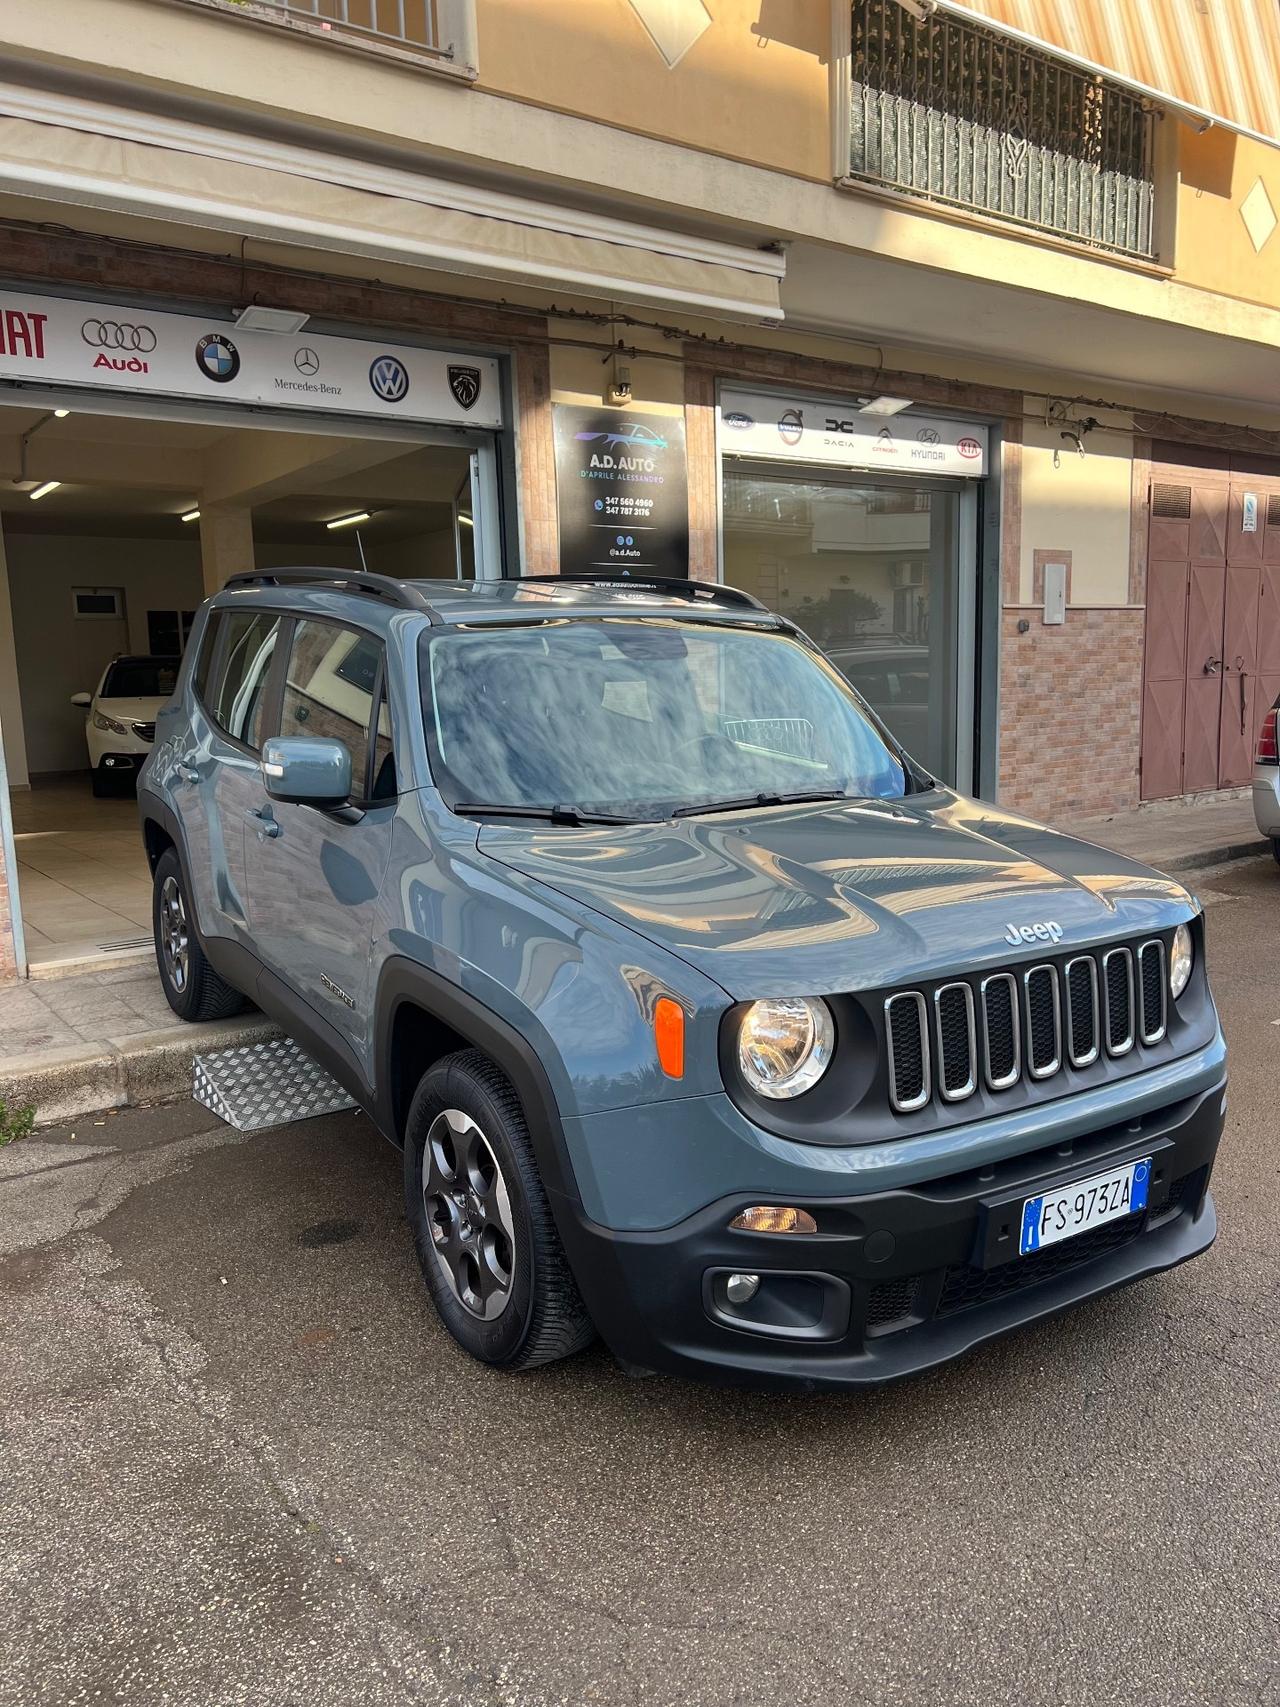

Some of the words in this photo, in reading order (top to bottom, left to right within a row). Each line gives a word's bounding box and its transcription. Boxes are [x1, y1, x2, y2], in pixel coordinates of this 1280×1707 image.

[199, 335, 235, 353] BMW
[93, 353, 149, 374] Audi
[274, 378, 342, 396] Mercedes-Benz
[823, 439, 854, 448] DACIA
[960, 442, 979, 454] KIA
[911, 449, 946, 461] HYUNDAI
[617, 473, 665, 484] ALESSANDRO
[605, 496, 619, 505] 347
[620, 497, 634, 506] 560
[605, 506, 619, 515] 347
[620, 506, 633, 516] 787
[633, 508, 650, 517] 3176
[1004, 920, 1064, 947] Jeep
